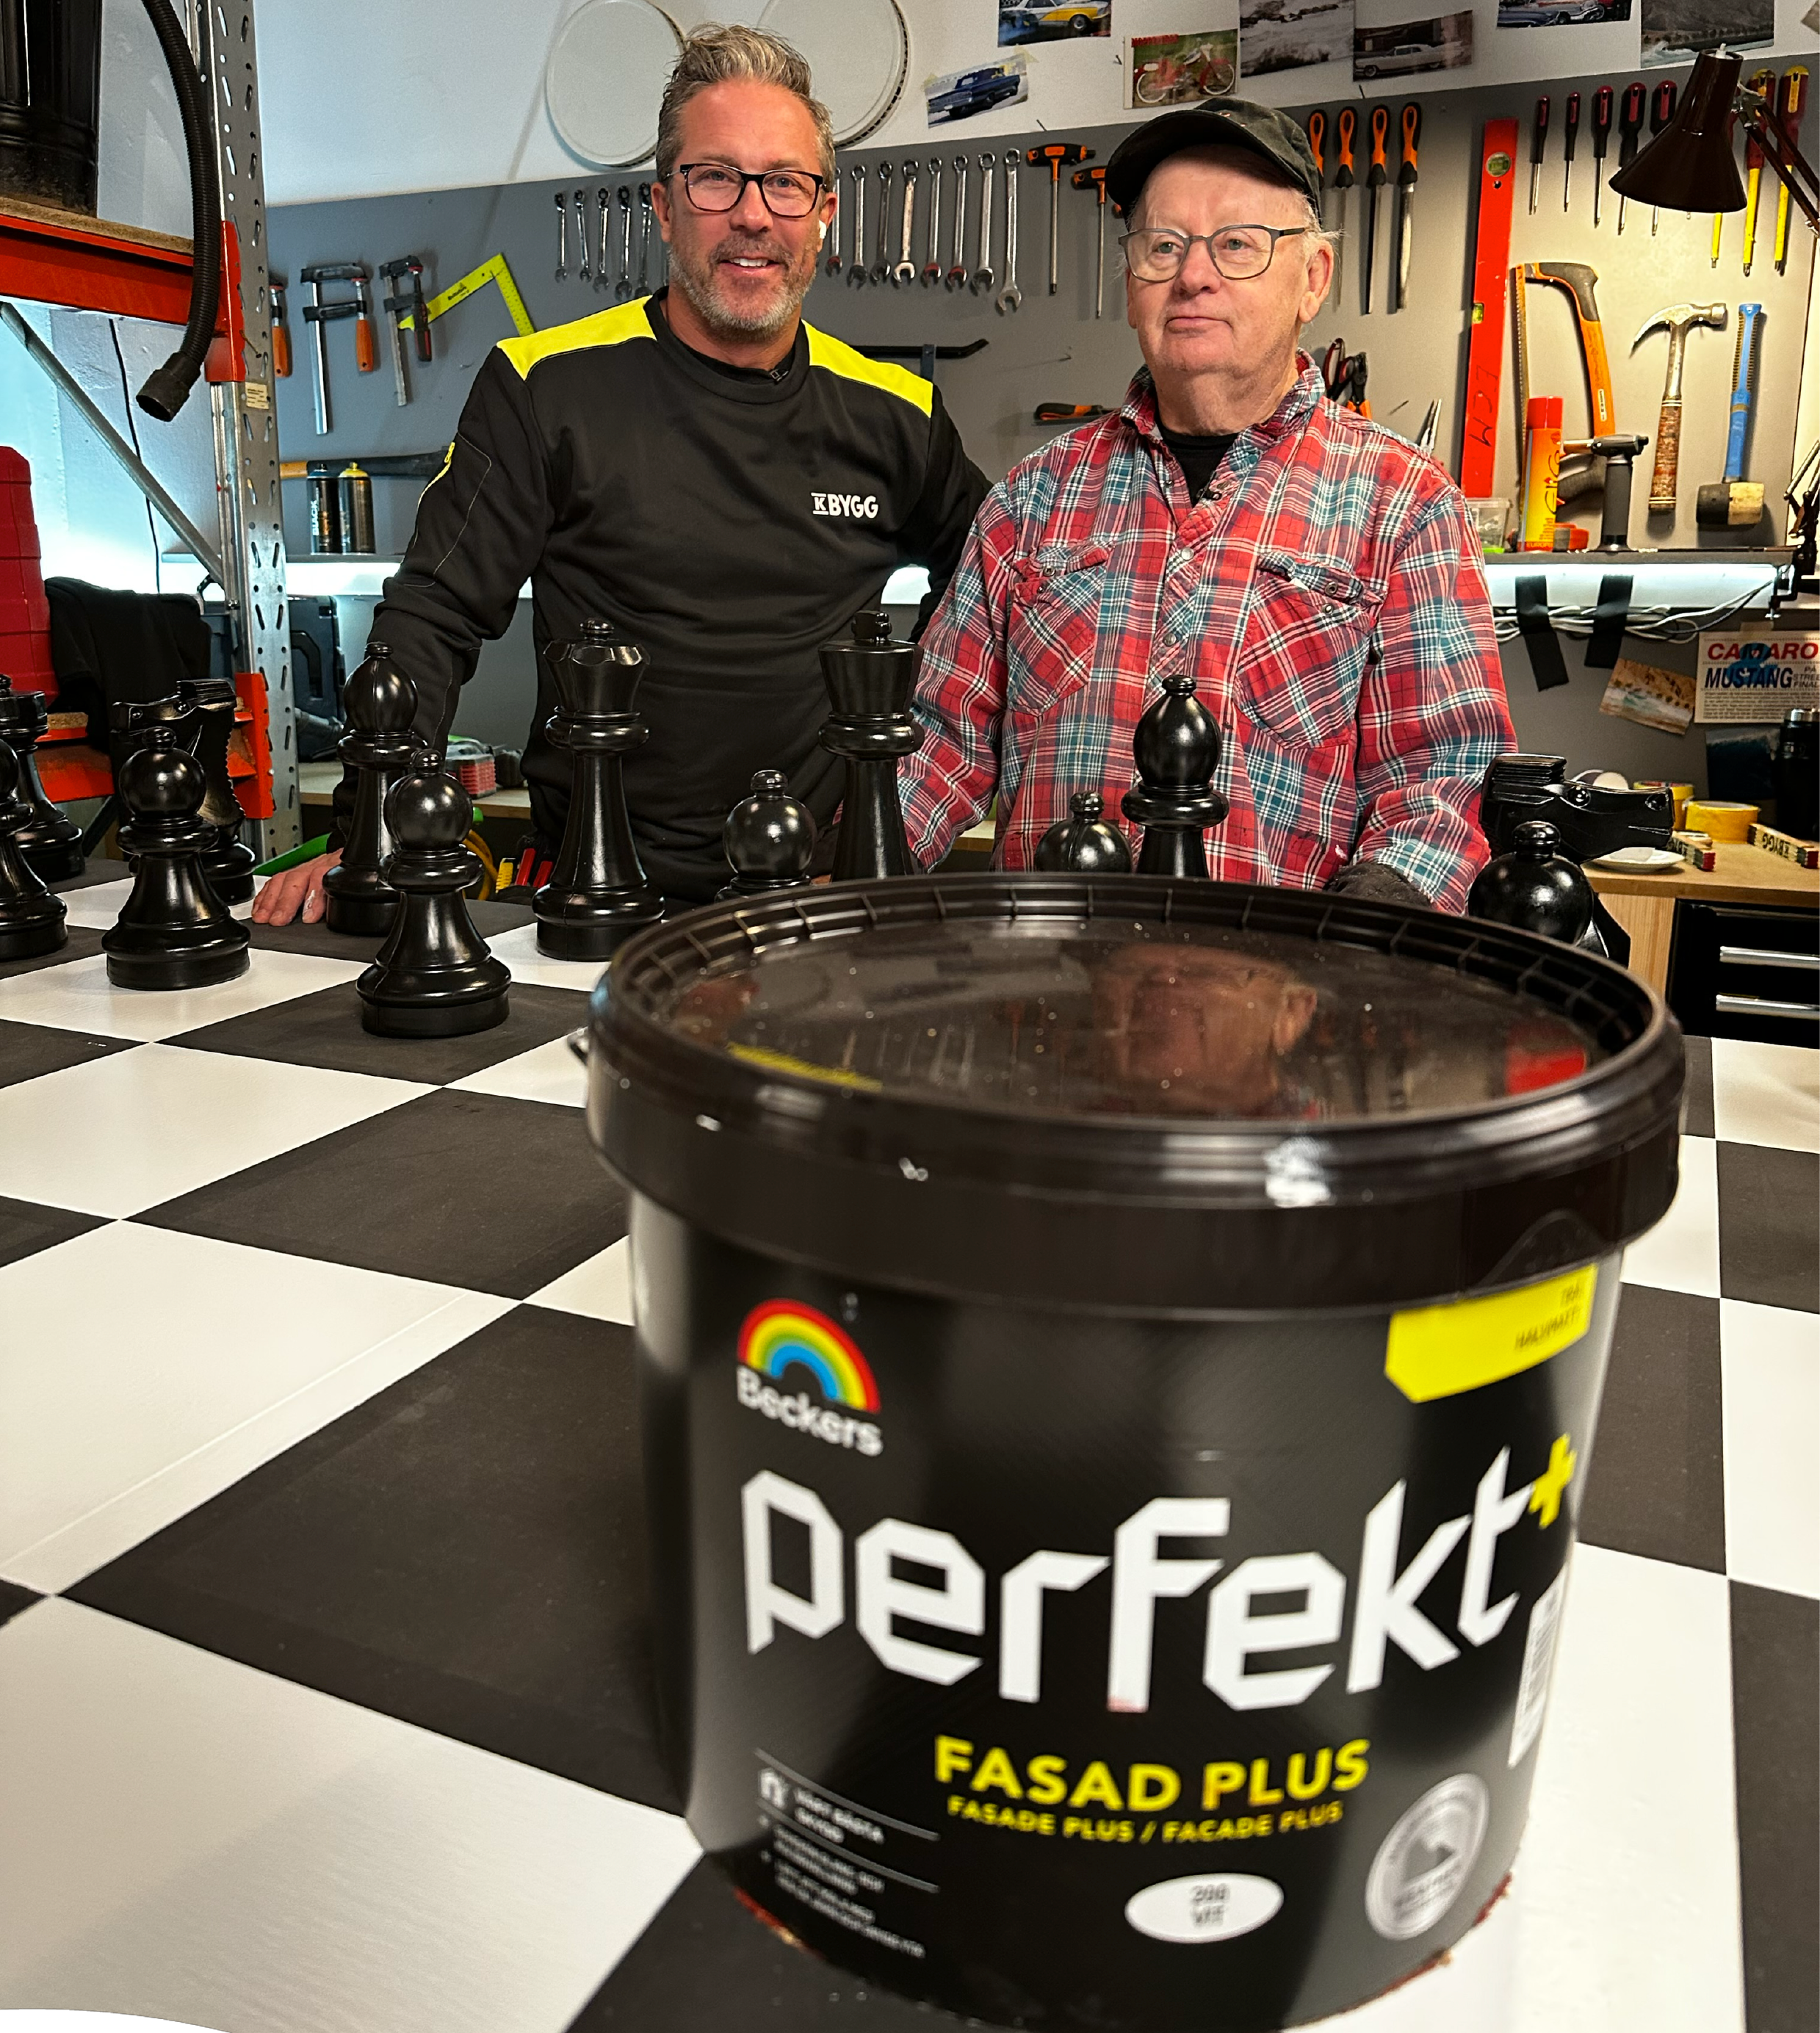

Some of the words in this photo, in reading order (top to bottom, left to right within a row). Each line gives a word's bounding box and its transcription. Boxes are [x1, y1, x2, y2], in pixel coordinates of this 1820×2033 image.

[1708, 643, 1819, 660] CAMARO
[1705, 668, 1793, 688] MUSTANG
[737, 1365, 883, 1456] Beckers
[935, 1736, 1181, 1812] FASAD
[1202, 1738, 1371, 1811] PLUS
[947, 1795, 1055, 1835] FASADE
[1062, 1816, 1135, 1843] PLUS
[1278, 1799, 1343, 1834] PLUS
